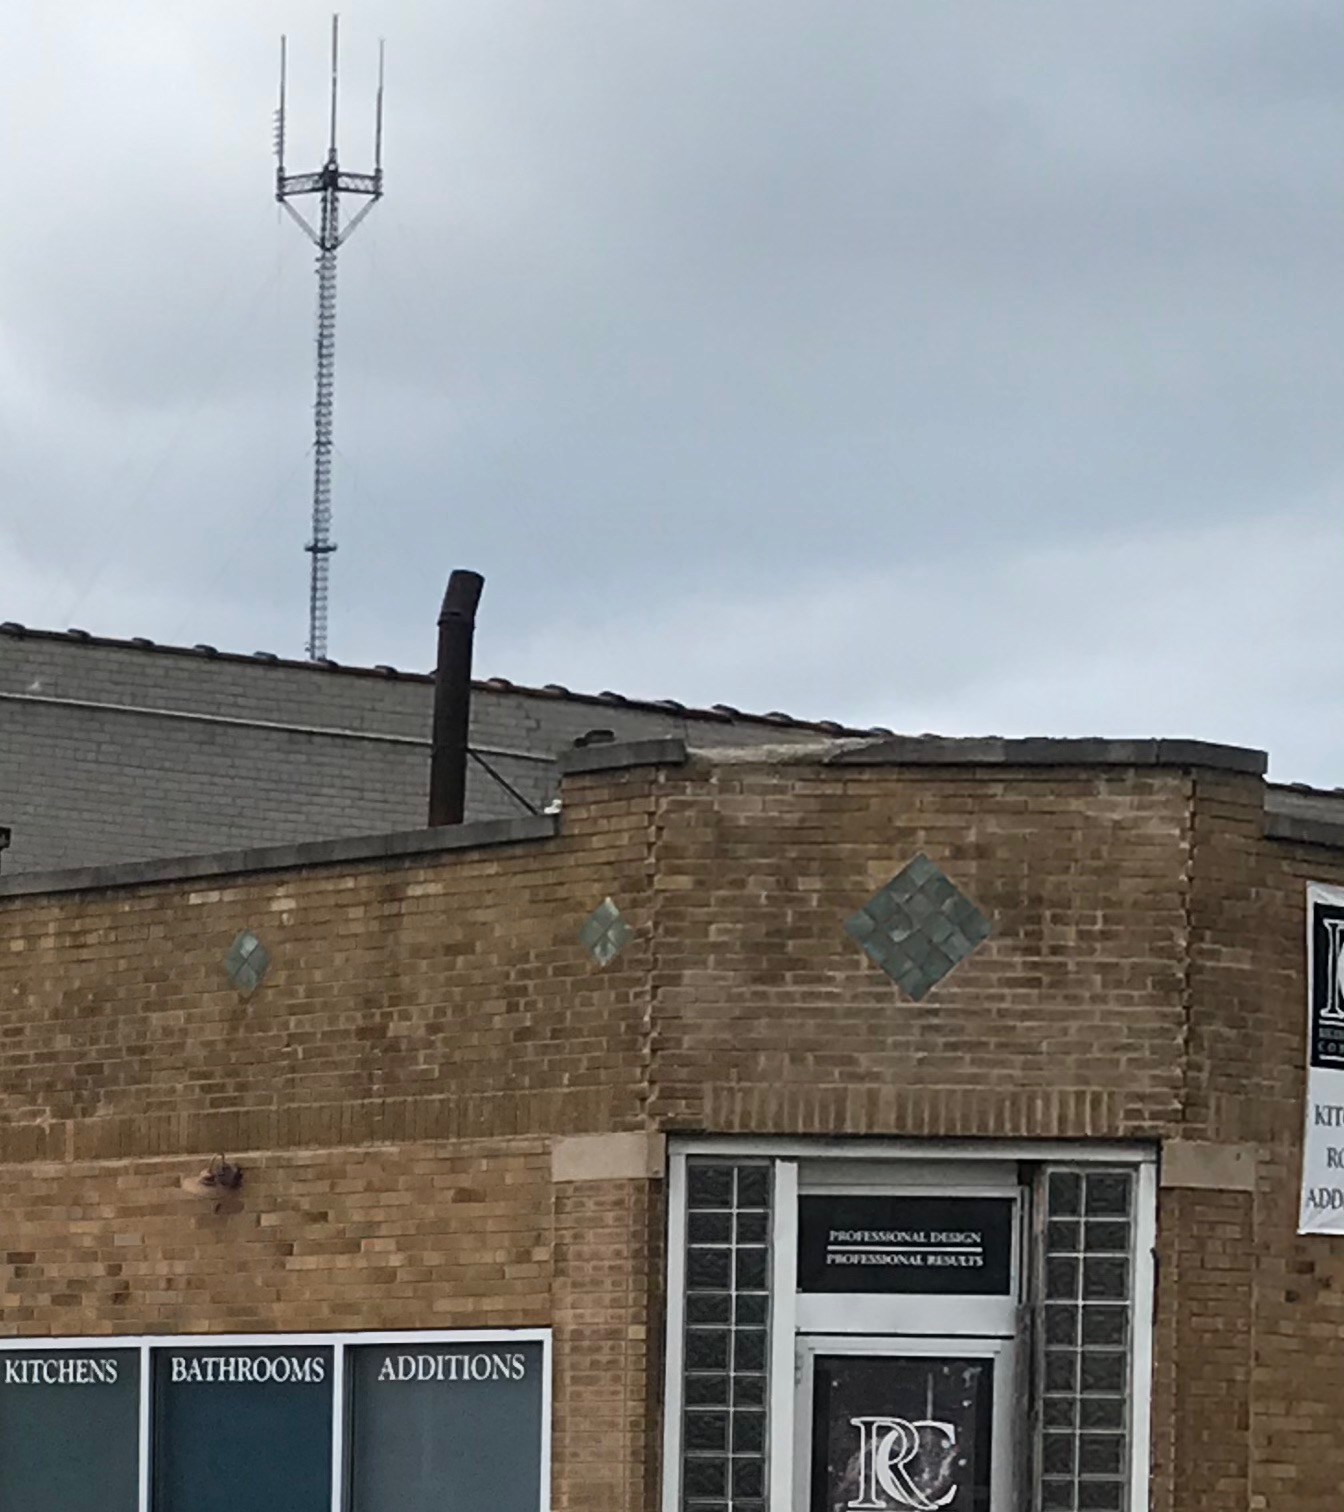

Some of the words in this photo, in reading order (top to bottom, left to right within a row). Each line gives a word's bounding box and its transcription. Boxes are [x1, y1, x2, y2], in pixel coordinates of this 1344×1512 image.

[1315, 1104, 1344, 1127] KIT
[829, 1230, 927, 1243] PROFESSIONAL
[930, 1231, 982, 1244] DESIGN
[826, 1253, 924, 1265] PROFESSIONAL
[927, 1254, 984, 1266] RESULTS
[5, 1359, 118, 1384] KITCHENS
[172, 1357, 325, 1382] BATHROOMS
[378, 1354, 525, 1381] ADDITIONS
